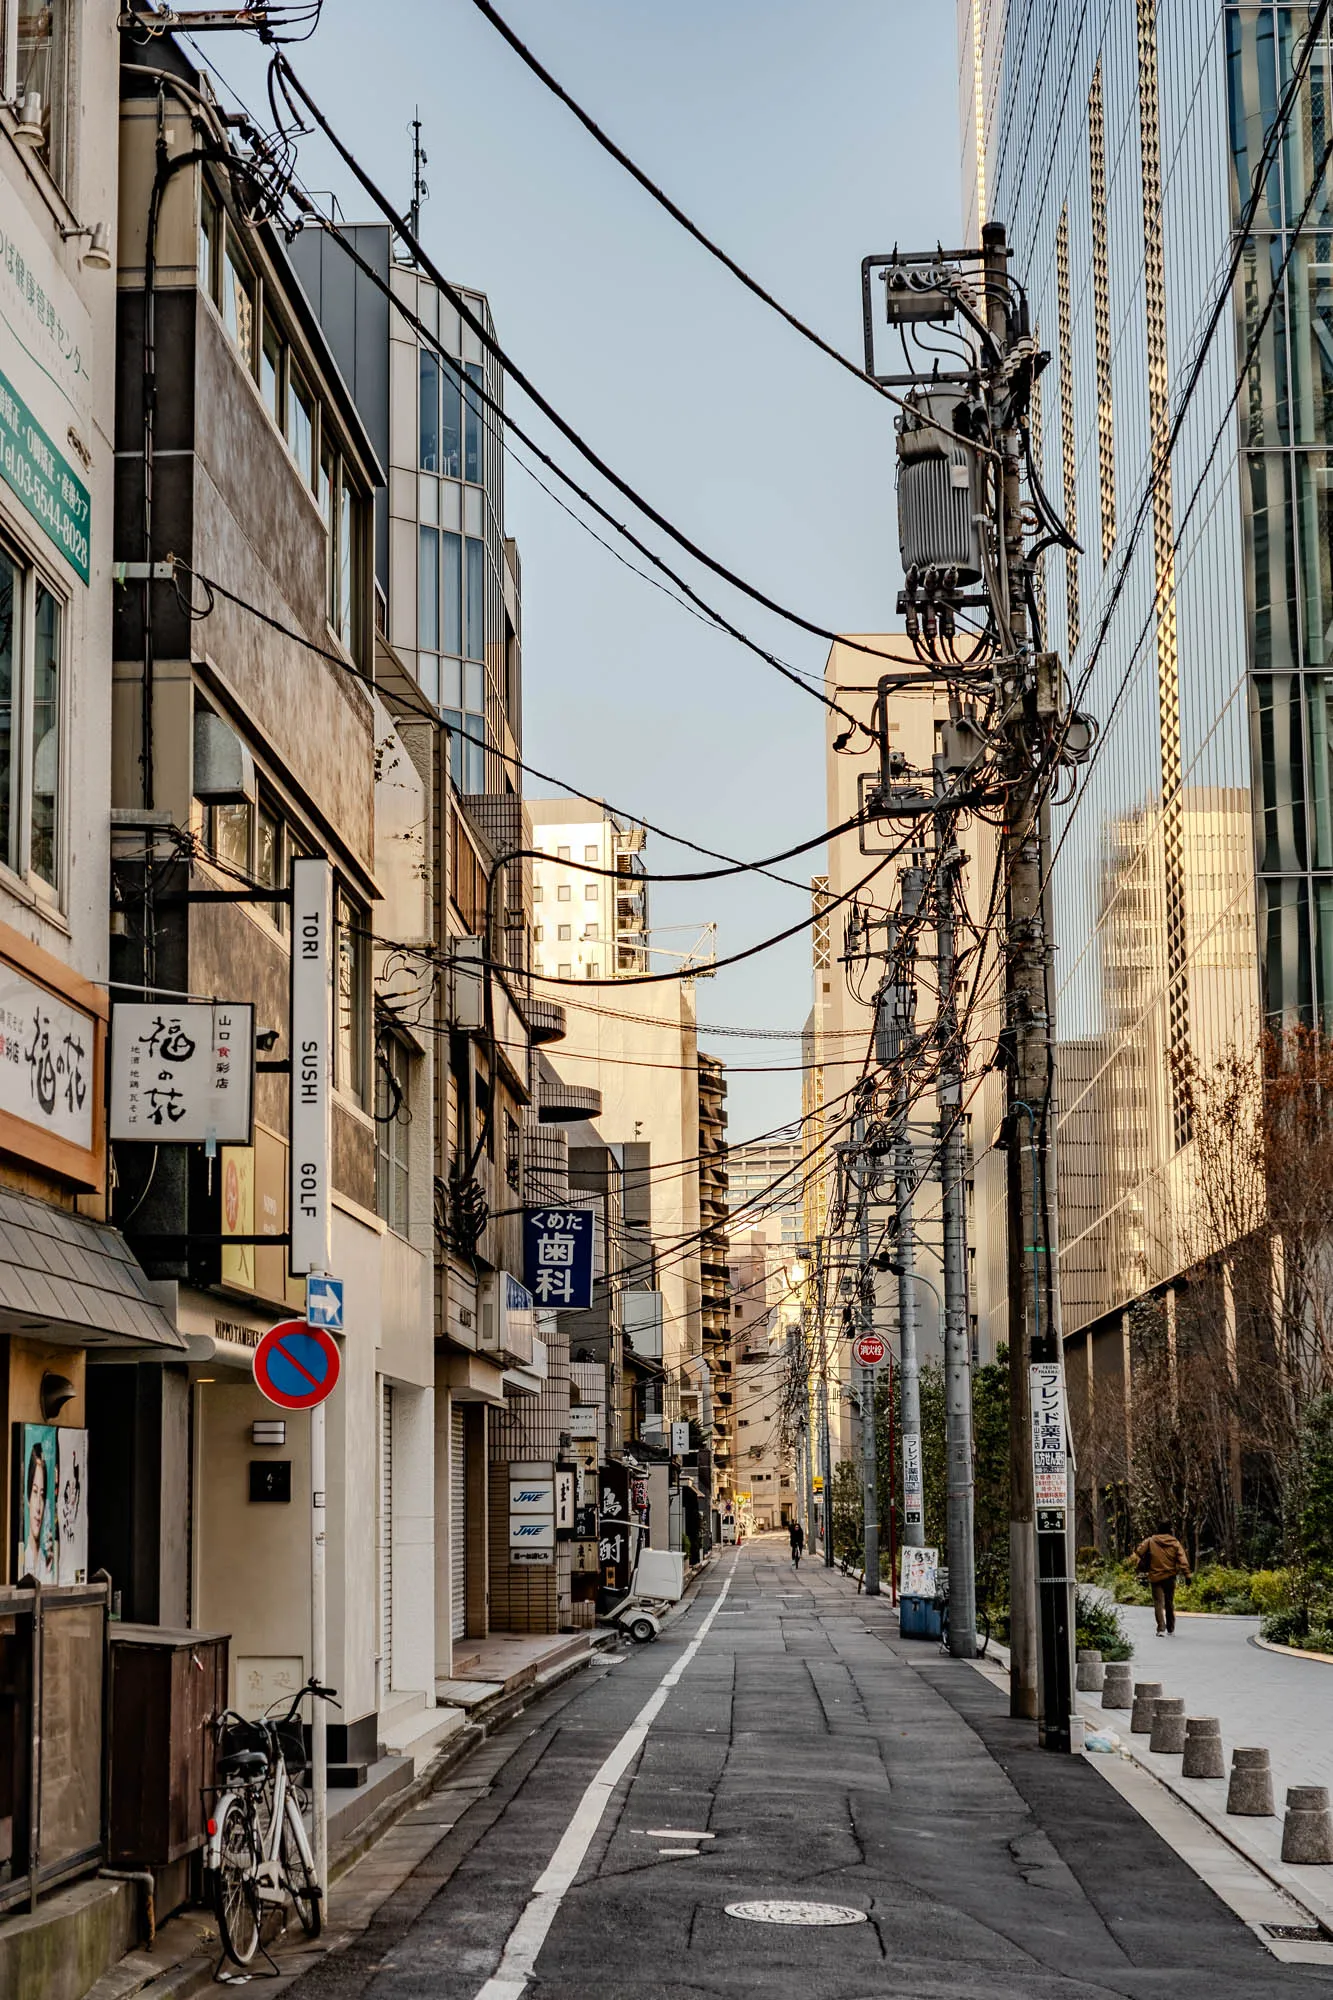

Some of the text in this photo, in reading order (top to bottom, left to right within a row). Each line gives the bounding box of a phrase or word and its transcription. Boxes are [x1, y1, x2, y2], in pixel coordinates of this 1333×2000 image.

[0, 228, 90, 381] ば健康管理センター
[302, 912, 319, 960] TORI
[138, 1016, 195, 1125] 福の花
[216, 1015, 231, 1089] 山口食彩店
[301, 1041, 318, 1104] SUSHI
[300, 1163, 317, 1217] GOLF
[531, 1212, 583, 1230] くめた
[535, 1232, 575, 1302] 歯科
[860, 1344, 883, 1355] 消火栓
[1040, 1375, 1060, 1450] フレンド薬局
[513, 1491, 551, 1502] JWE
[513, 1524, 551, 1536] JWE
[1043, 1521, 1061, 1529] 2-4
